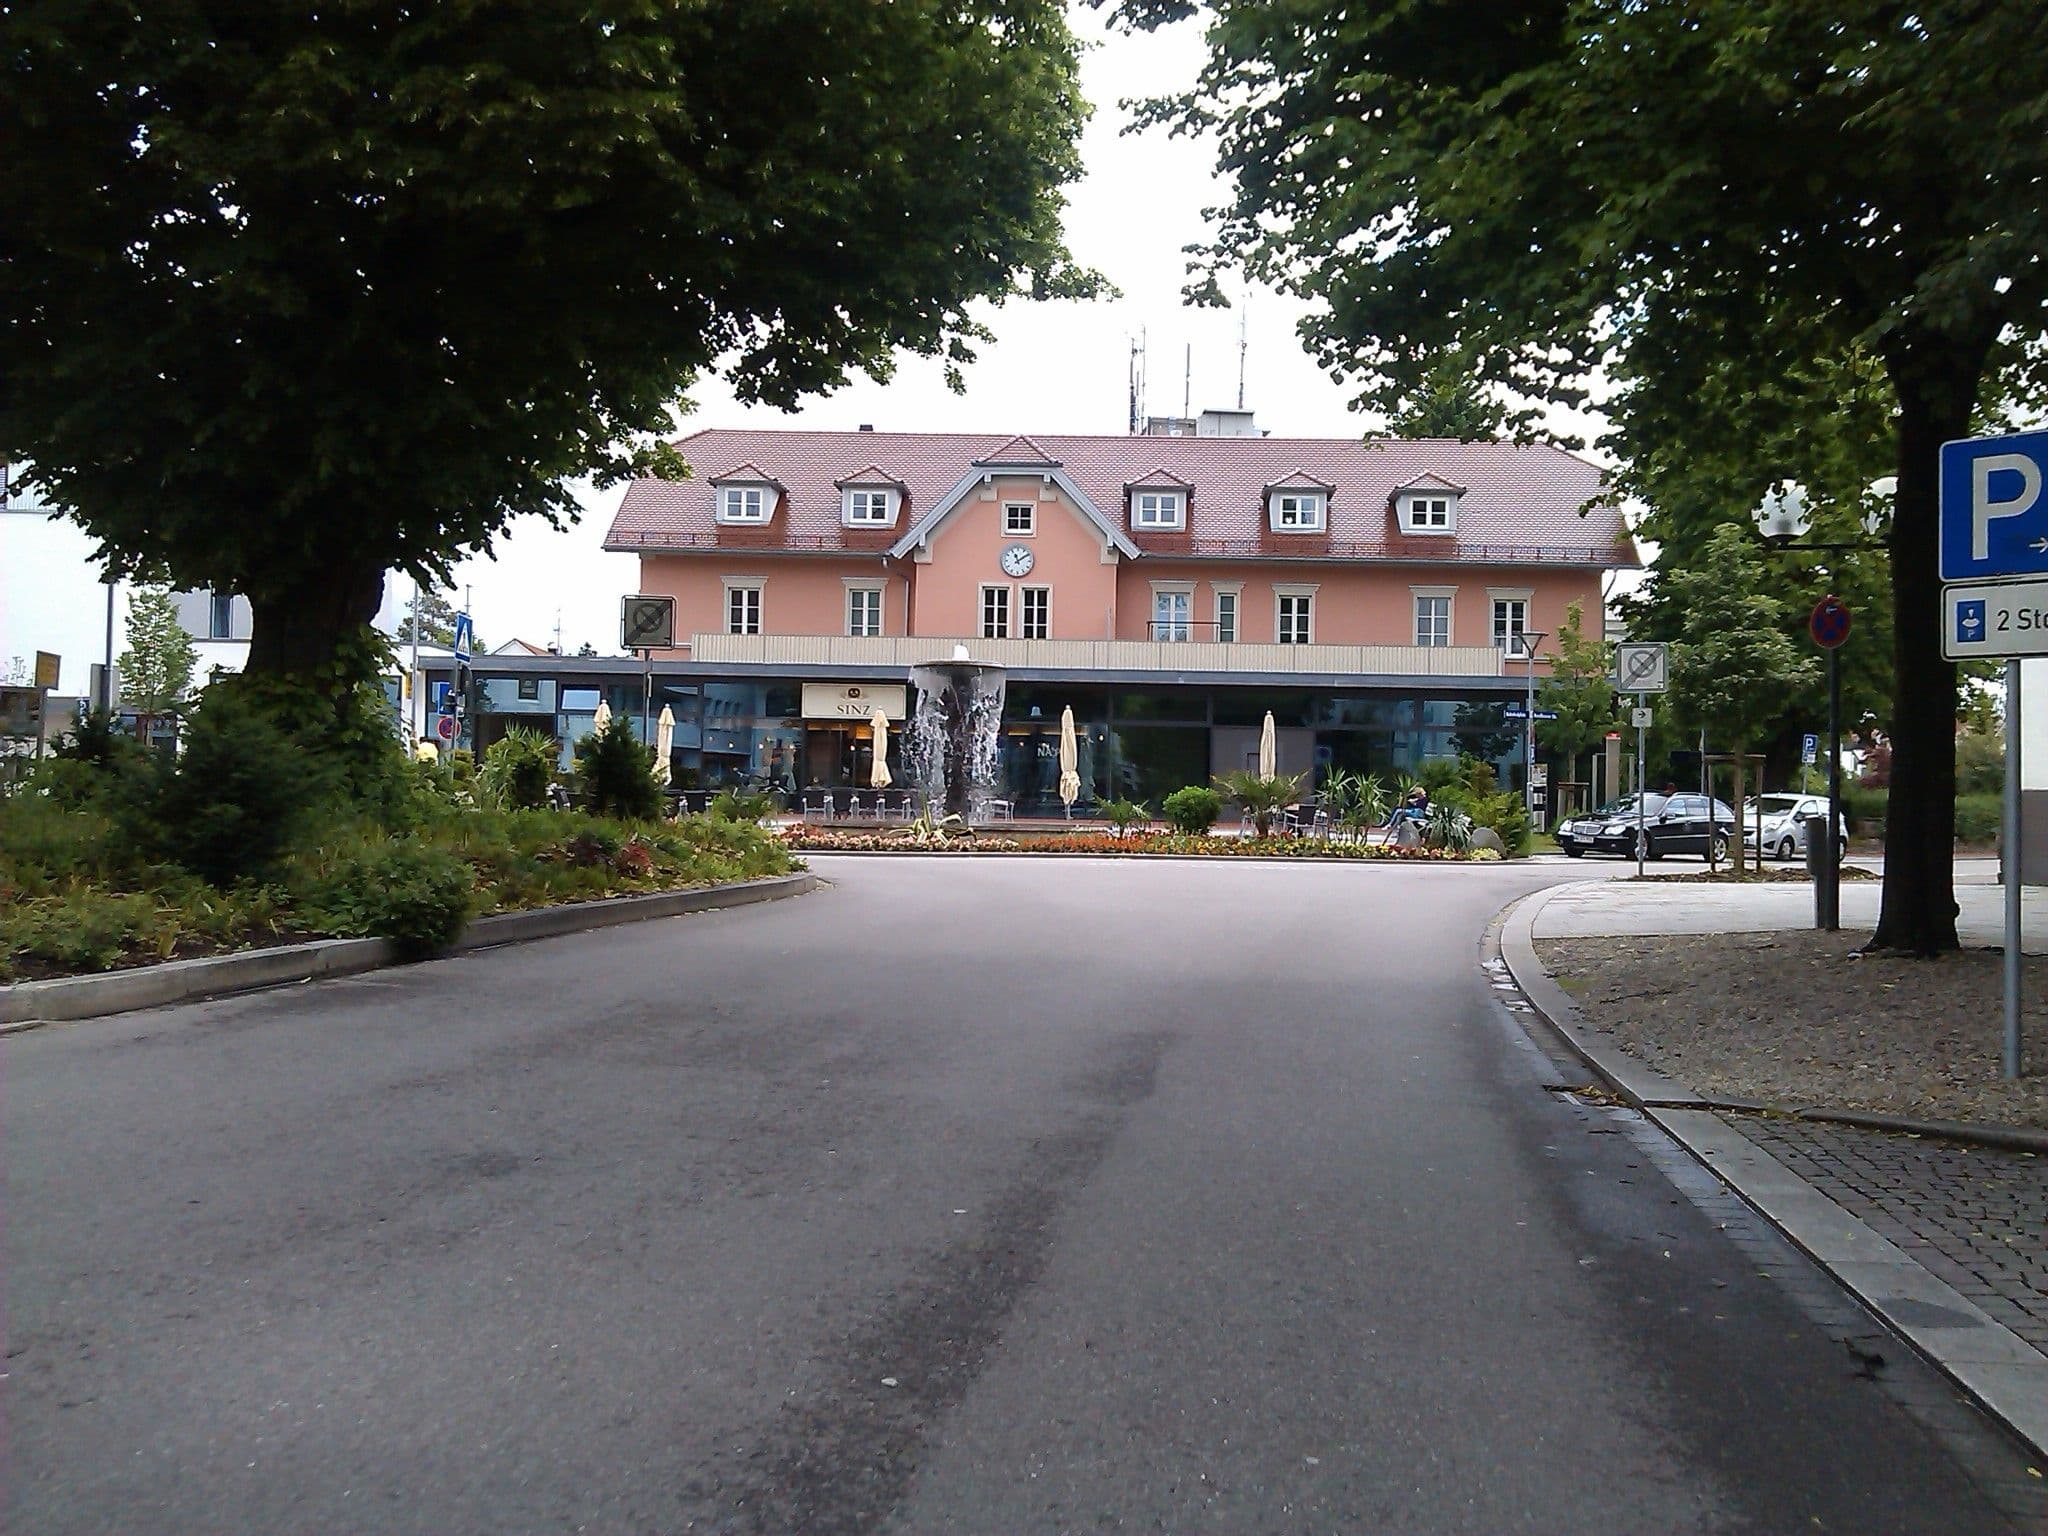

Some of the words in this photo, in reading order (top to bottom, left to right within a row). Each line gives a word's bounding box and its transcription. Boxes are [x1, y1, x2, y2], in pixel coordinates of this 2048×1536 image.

[1972, 453, 2042, 561] P
[1997, 609, 2010, 632] 2
[836, 704, 872, 716] SINZ
[1805, 737, 1814, 751] P
